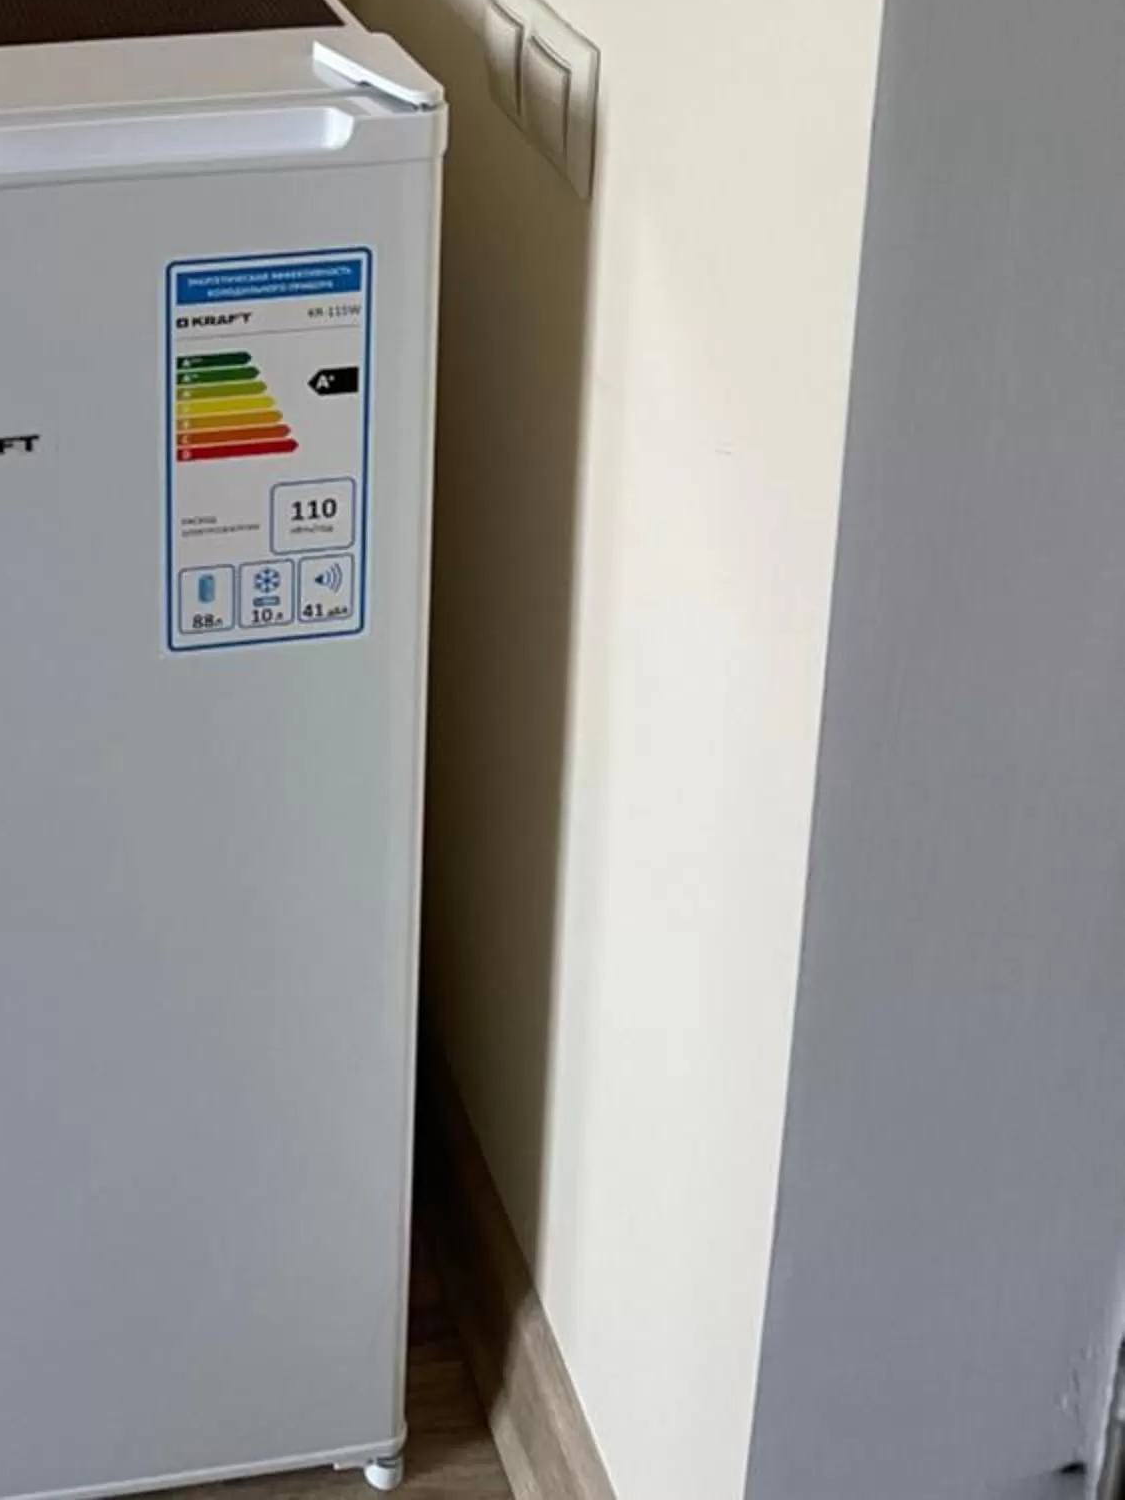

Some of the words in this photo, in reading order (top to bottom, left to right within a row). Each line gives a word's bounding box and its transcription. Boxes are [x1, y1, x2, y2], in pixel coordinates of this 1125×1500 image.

[192, 312, 251, 327] KRAFT
[290, 497, 338, 522] 110
[251, 608, 274, 624] 10
[302, 603, 324, 618] 41
